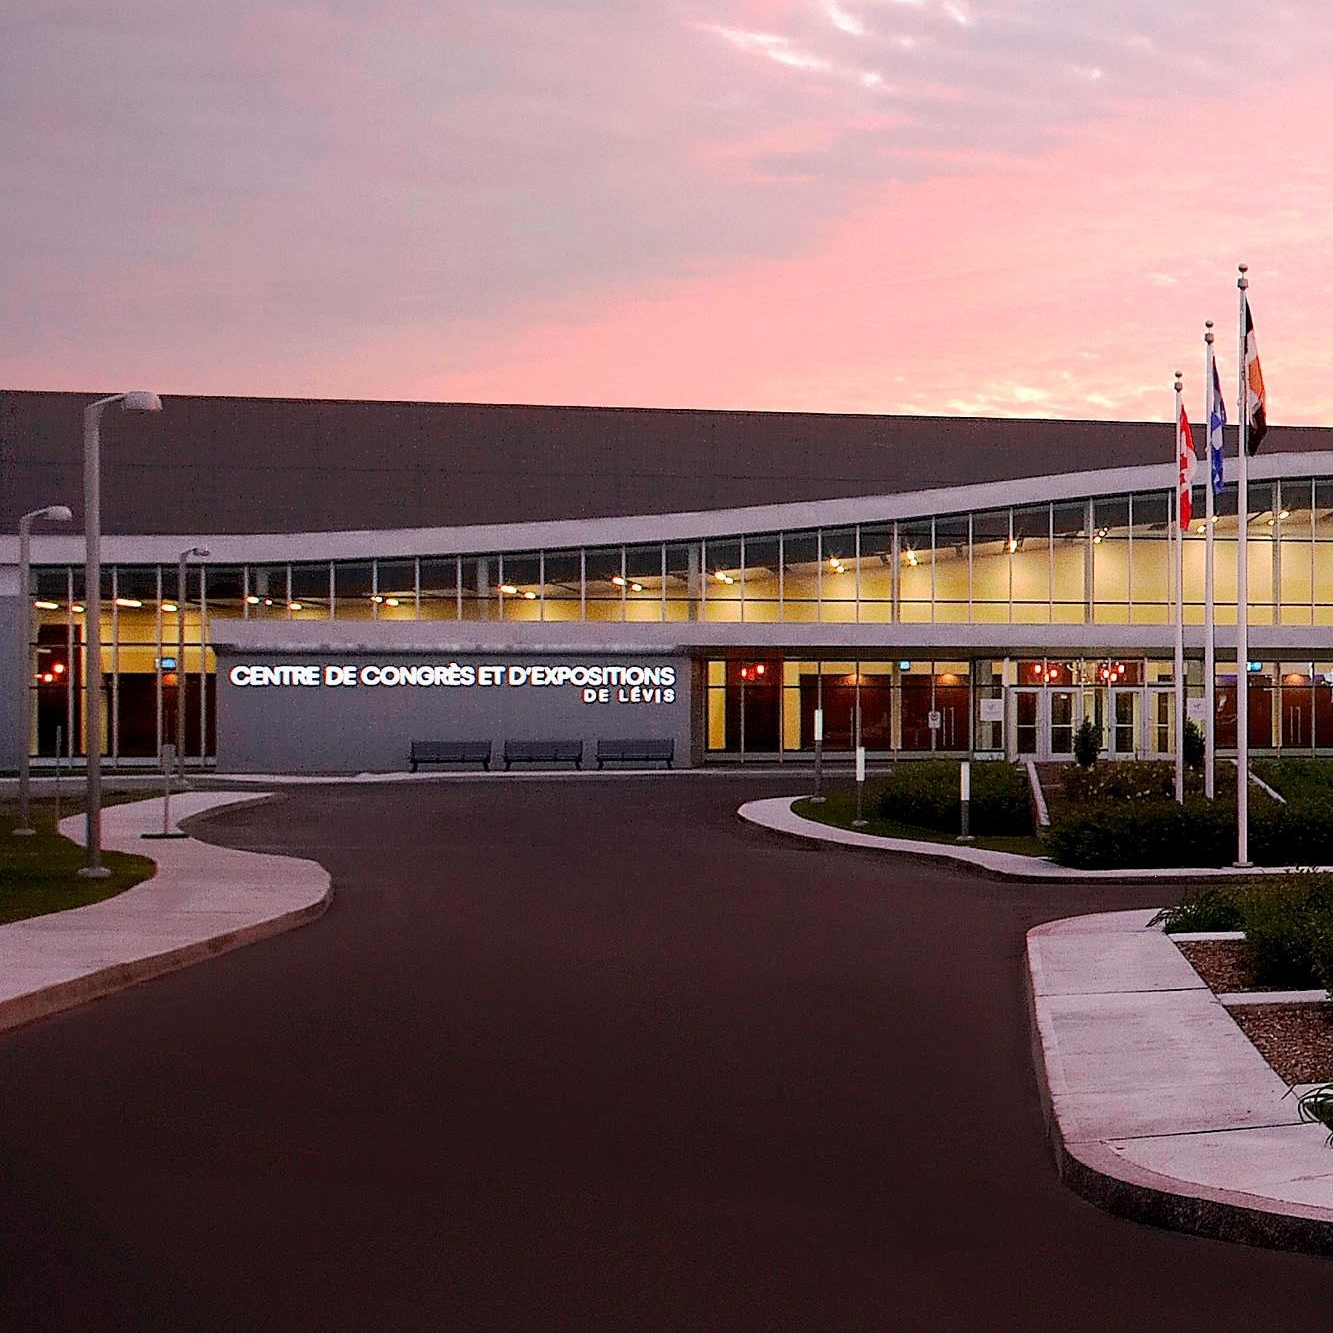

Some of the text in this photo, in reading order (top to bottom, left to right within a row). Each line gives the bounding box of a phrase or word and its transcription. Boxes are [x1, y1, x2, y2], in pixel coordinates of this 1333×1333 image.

[229, 663, 676, 687] CENTRE DE CONGRÈS ET D'EXPOSITIONS
[582, 686, 675, 703] DE LÉVIS
